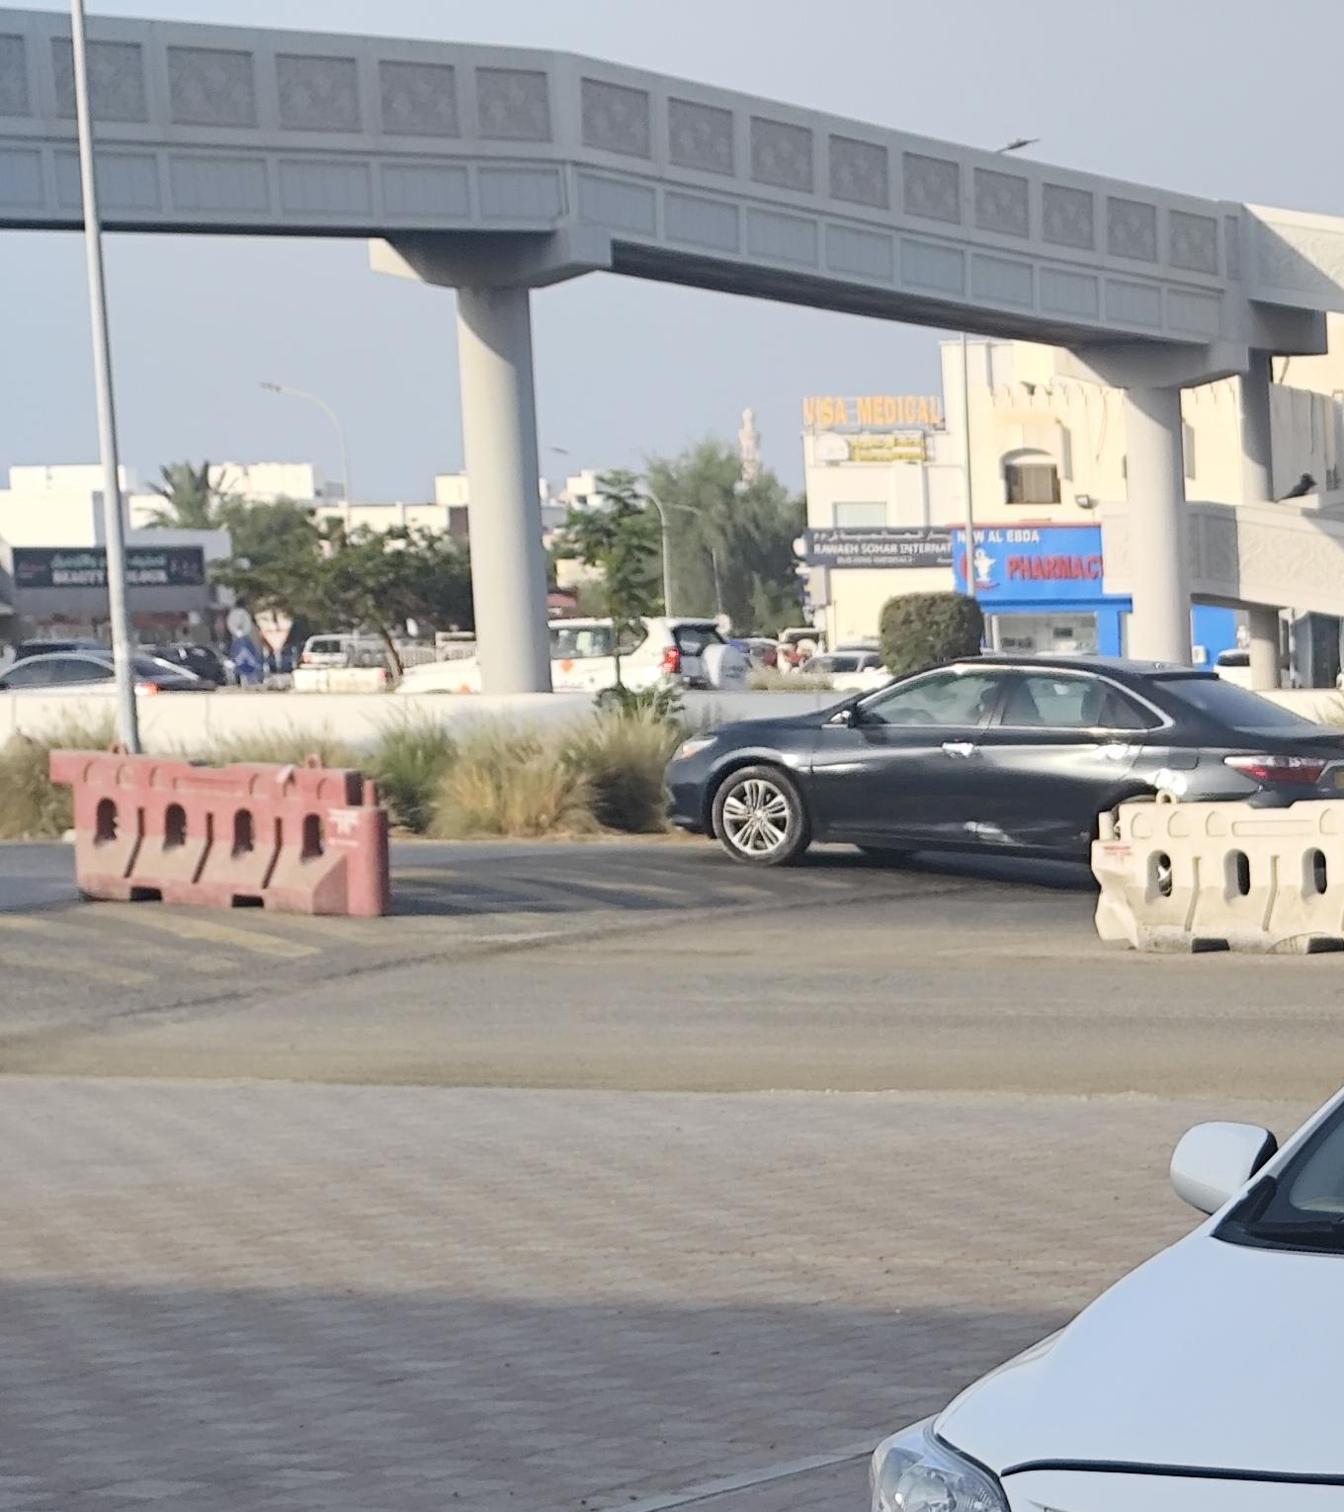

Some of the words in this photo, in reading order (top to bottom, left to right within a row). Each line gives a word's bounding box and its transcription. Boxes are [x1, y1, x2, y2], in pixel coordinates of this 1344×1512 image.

[803, 395, 847, 426] VISA
[857, 395, 941, 425] MEDICAL
[957, 530, 985, 543] NW
[988, 530, 1003, 543] AL
[1006, 556, 1103, 580] PHARMAC
